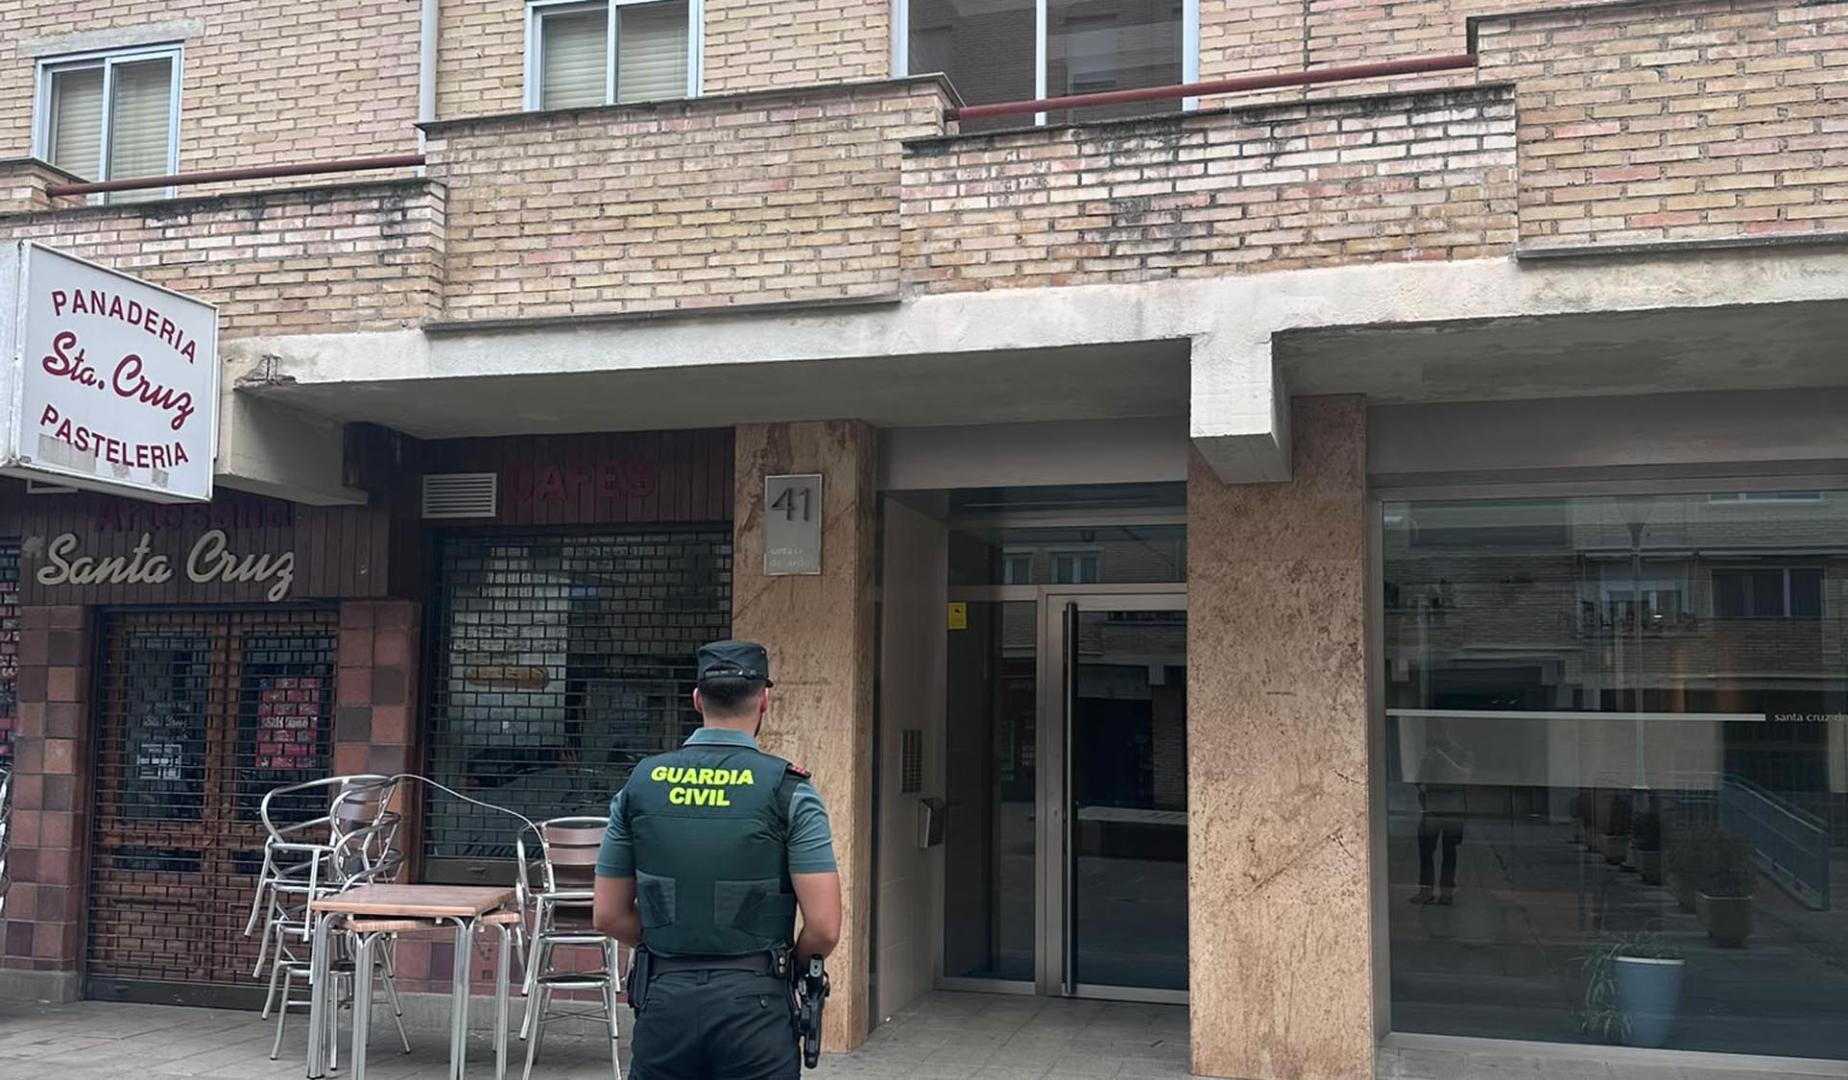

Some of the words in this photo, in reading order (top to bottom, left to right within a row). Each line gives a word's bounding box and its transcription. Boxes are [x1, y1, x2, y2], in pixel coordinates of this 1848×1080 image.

[52, 289, 196, 364] PANADERIA
[42, 331, 105, 390] Sta.
[112, 354, 194, 431] Cruz
[40, 404, 189, 468] PASTELERIA
[771, 487, 810, 522] 41
[36, 532, 173, 586] Santa
[187, 528, 294, 602] Cruz
[1774, 713, 1804, 722] santa
[1806, 713, 1830, 722] cruz
[650, 766, 754, 786] GUARDIA
[668, 787, 731, 807] CIVIL
